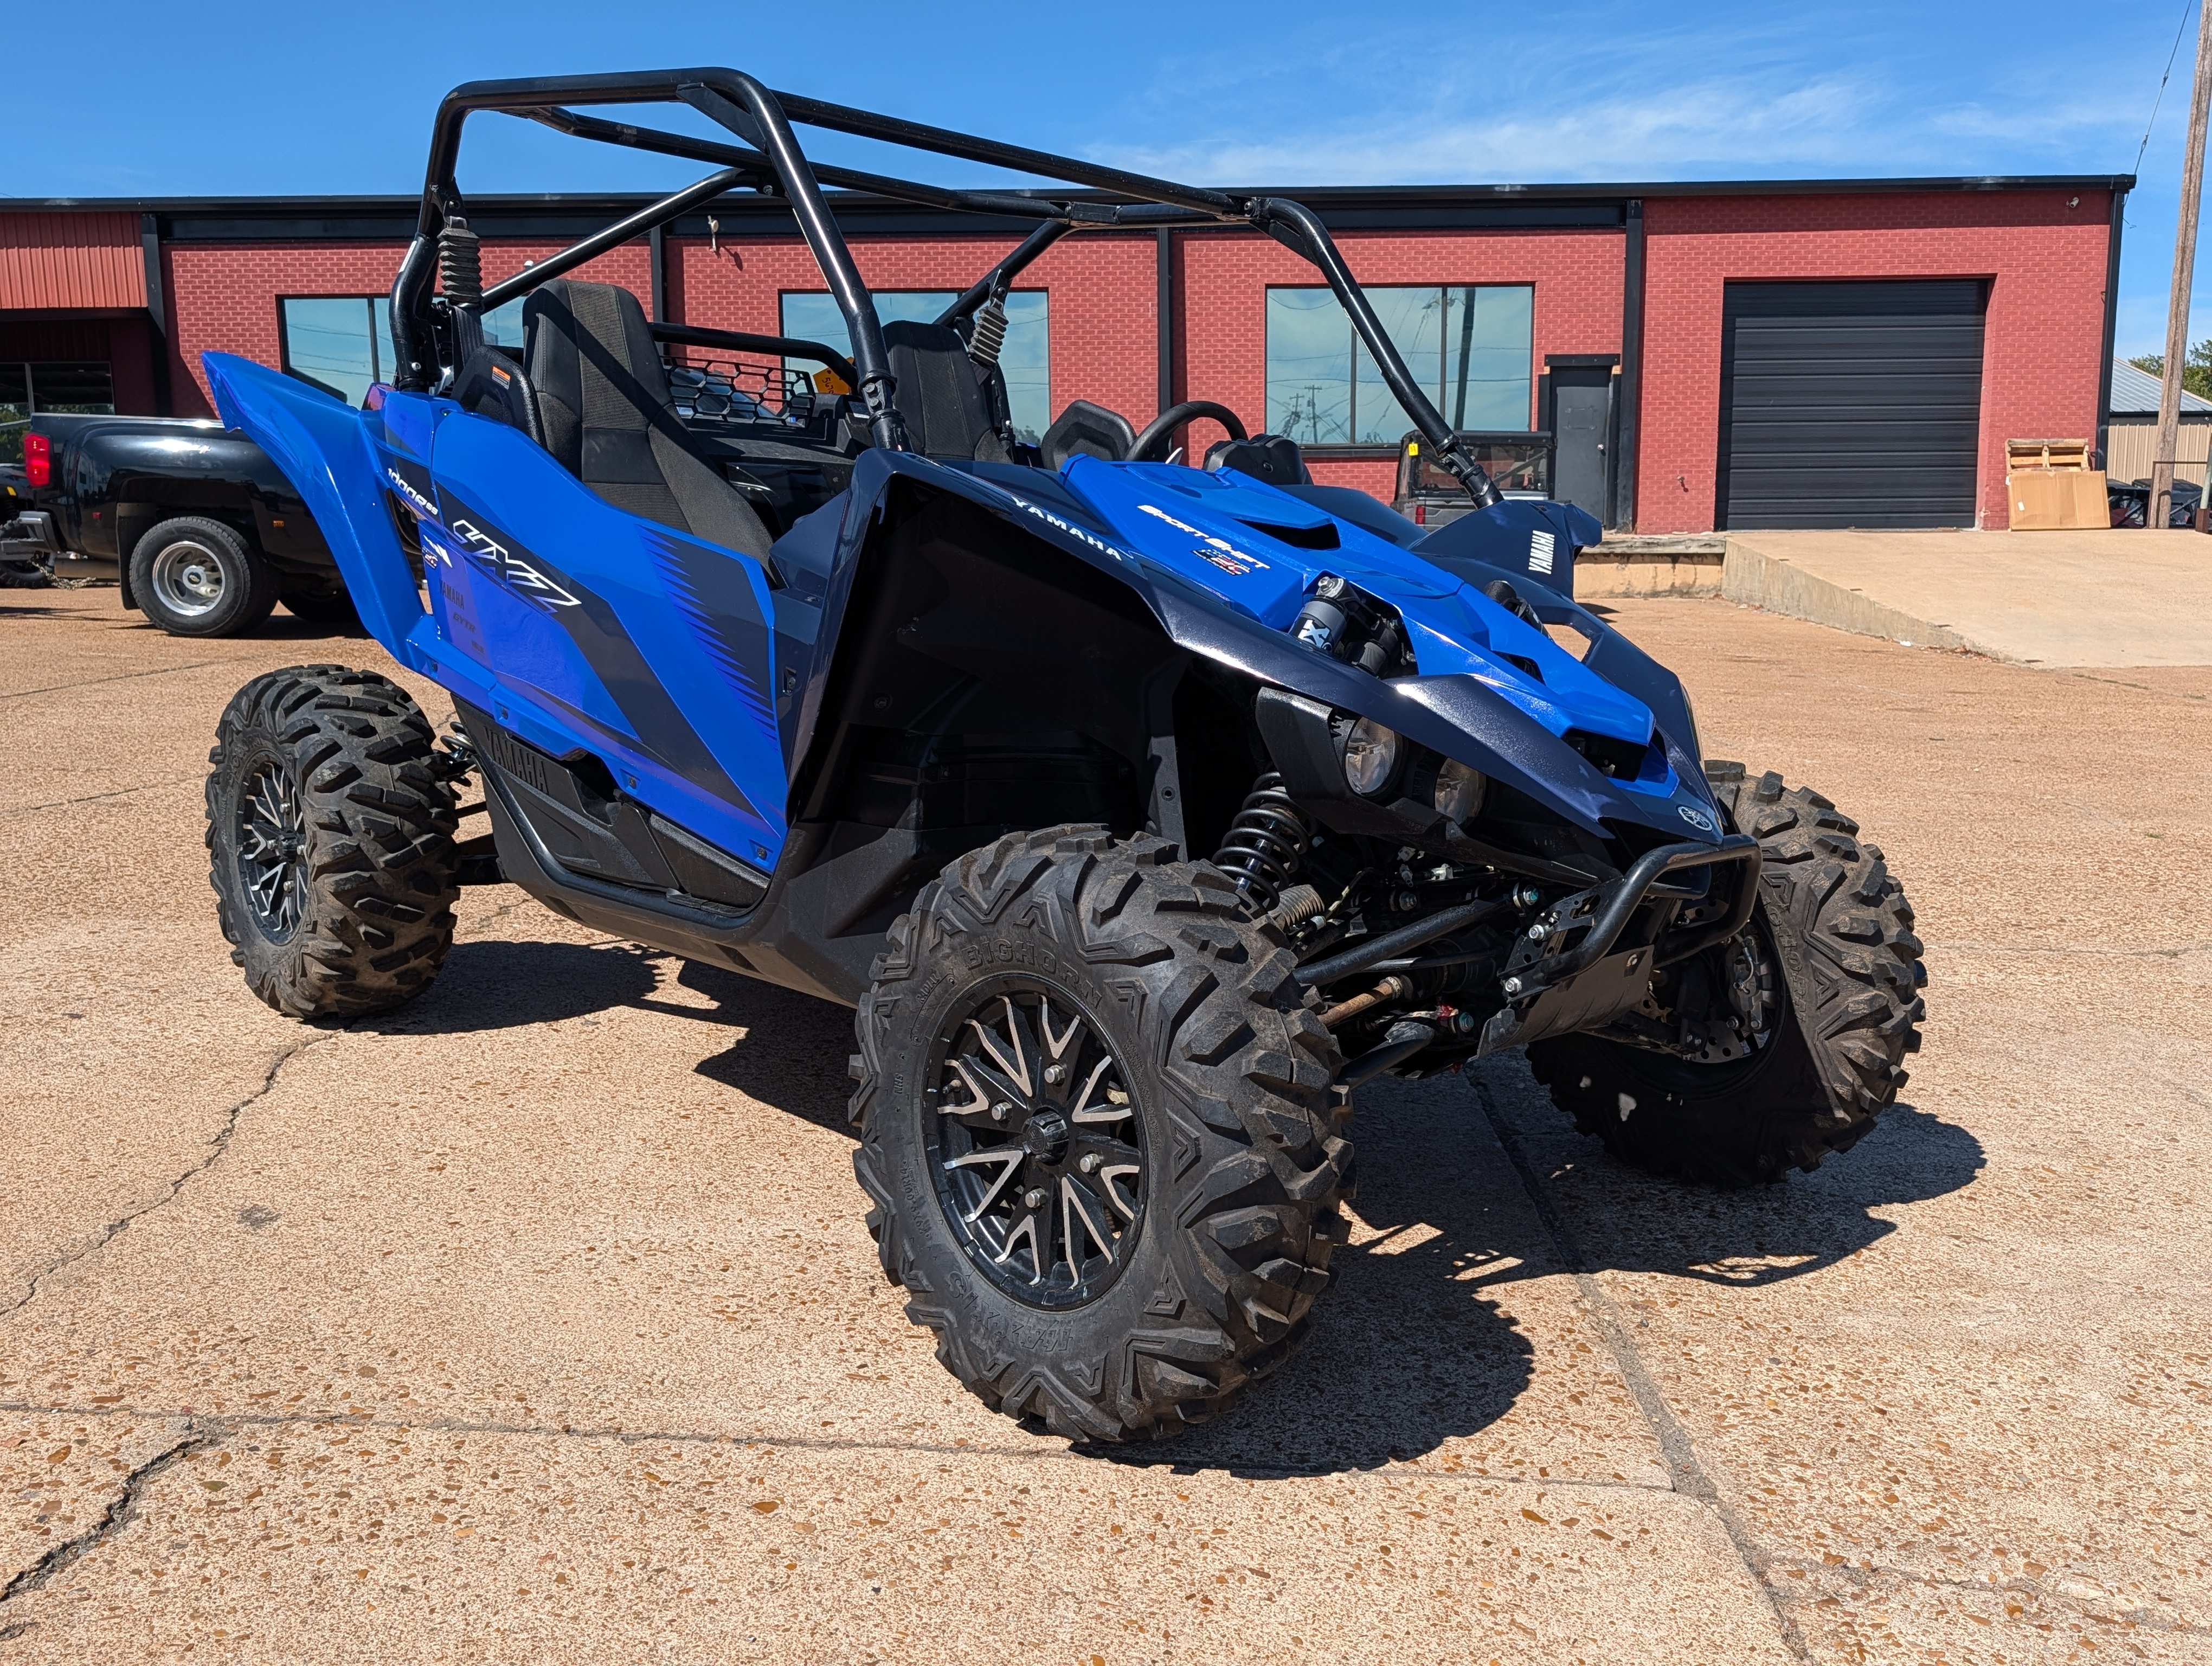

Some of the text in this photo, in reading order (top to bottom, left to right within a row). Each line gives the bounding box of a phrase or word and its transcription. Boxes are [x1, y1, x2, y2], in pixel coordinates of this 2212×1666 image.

[1011, 496, 1122, 561] YAMAHA
[1528, 529, 1555, 575] YAMAHA
[439, 578, 465, 611] YAMAHA
[483, 726, 550, 796] YAMAHA
[961, 939, 1103, 1009] BIGHORN
